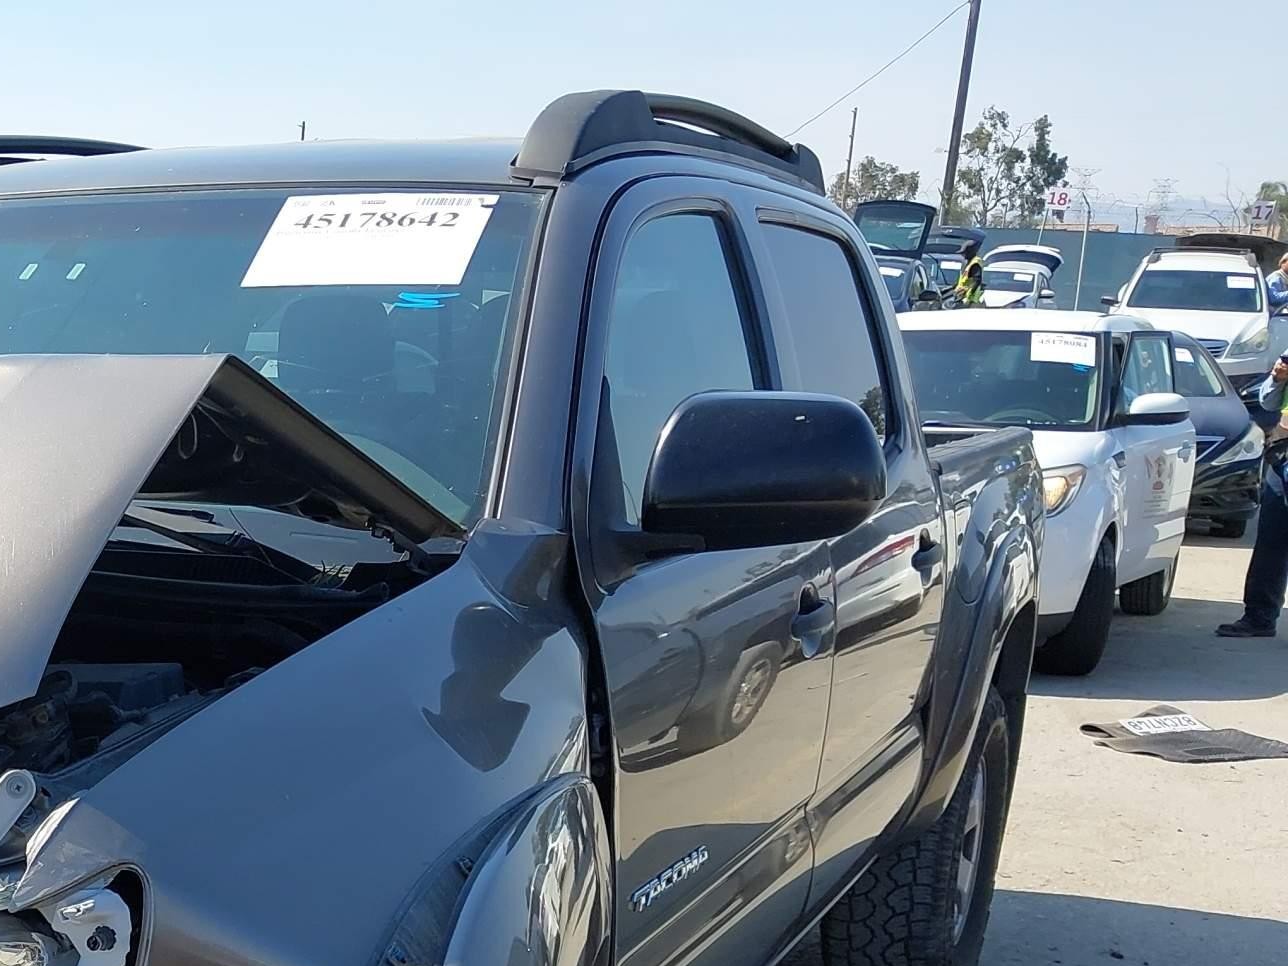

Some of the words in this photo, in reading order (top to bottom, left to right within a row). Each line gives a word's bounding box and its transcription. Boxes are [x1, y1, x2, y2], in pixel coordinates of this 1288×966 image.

[1047, 191, 1068, 206] 18
[293, 211, 461, 229] 45178642
[1251, 205, 1274, 220] 17
[630, 845, 709, 912] TACOMA
